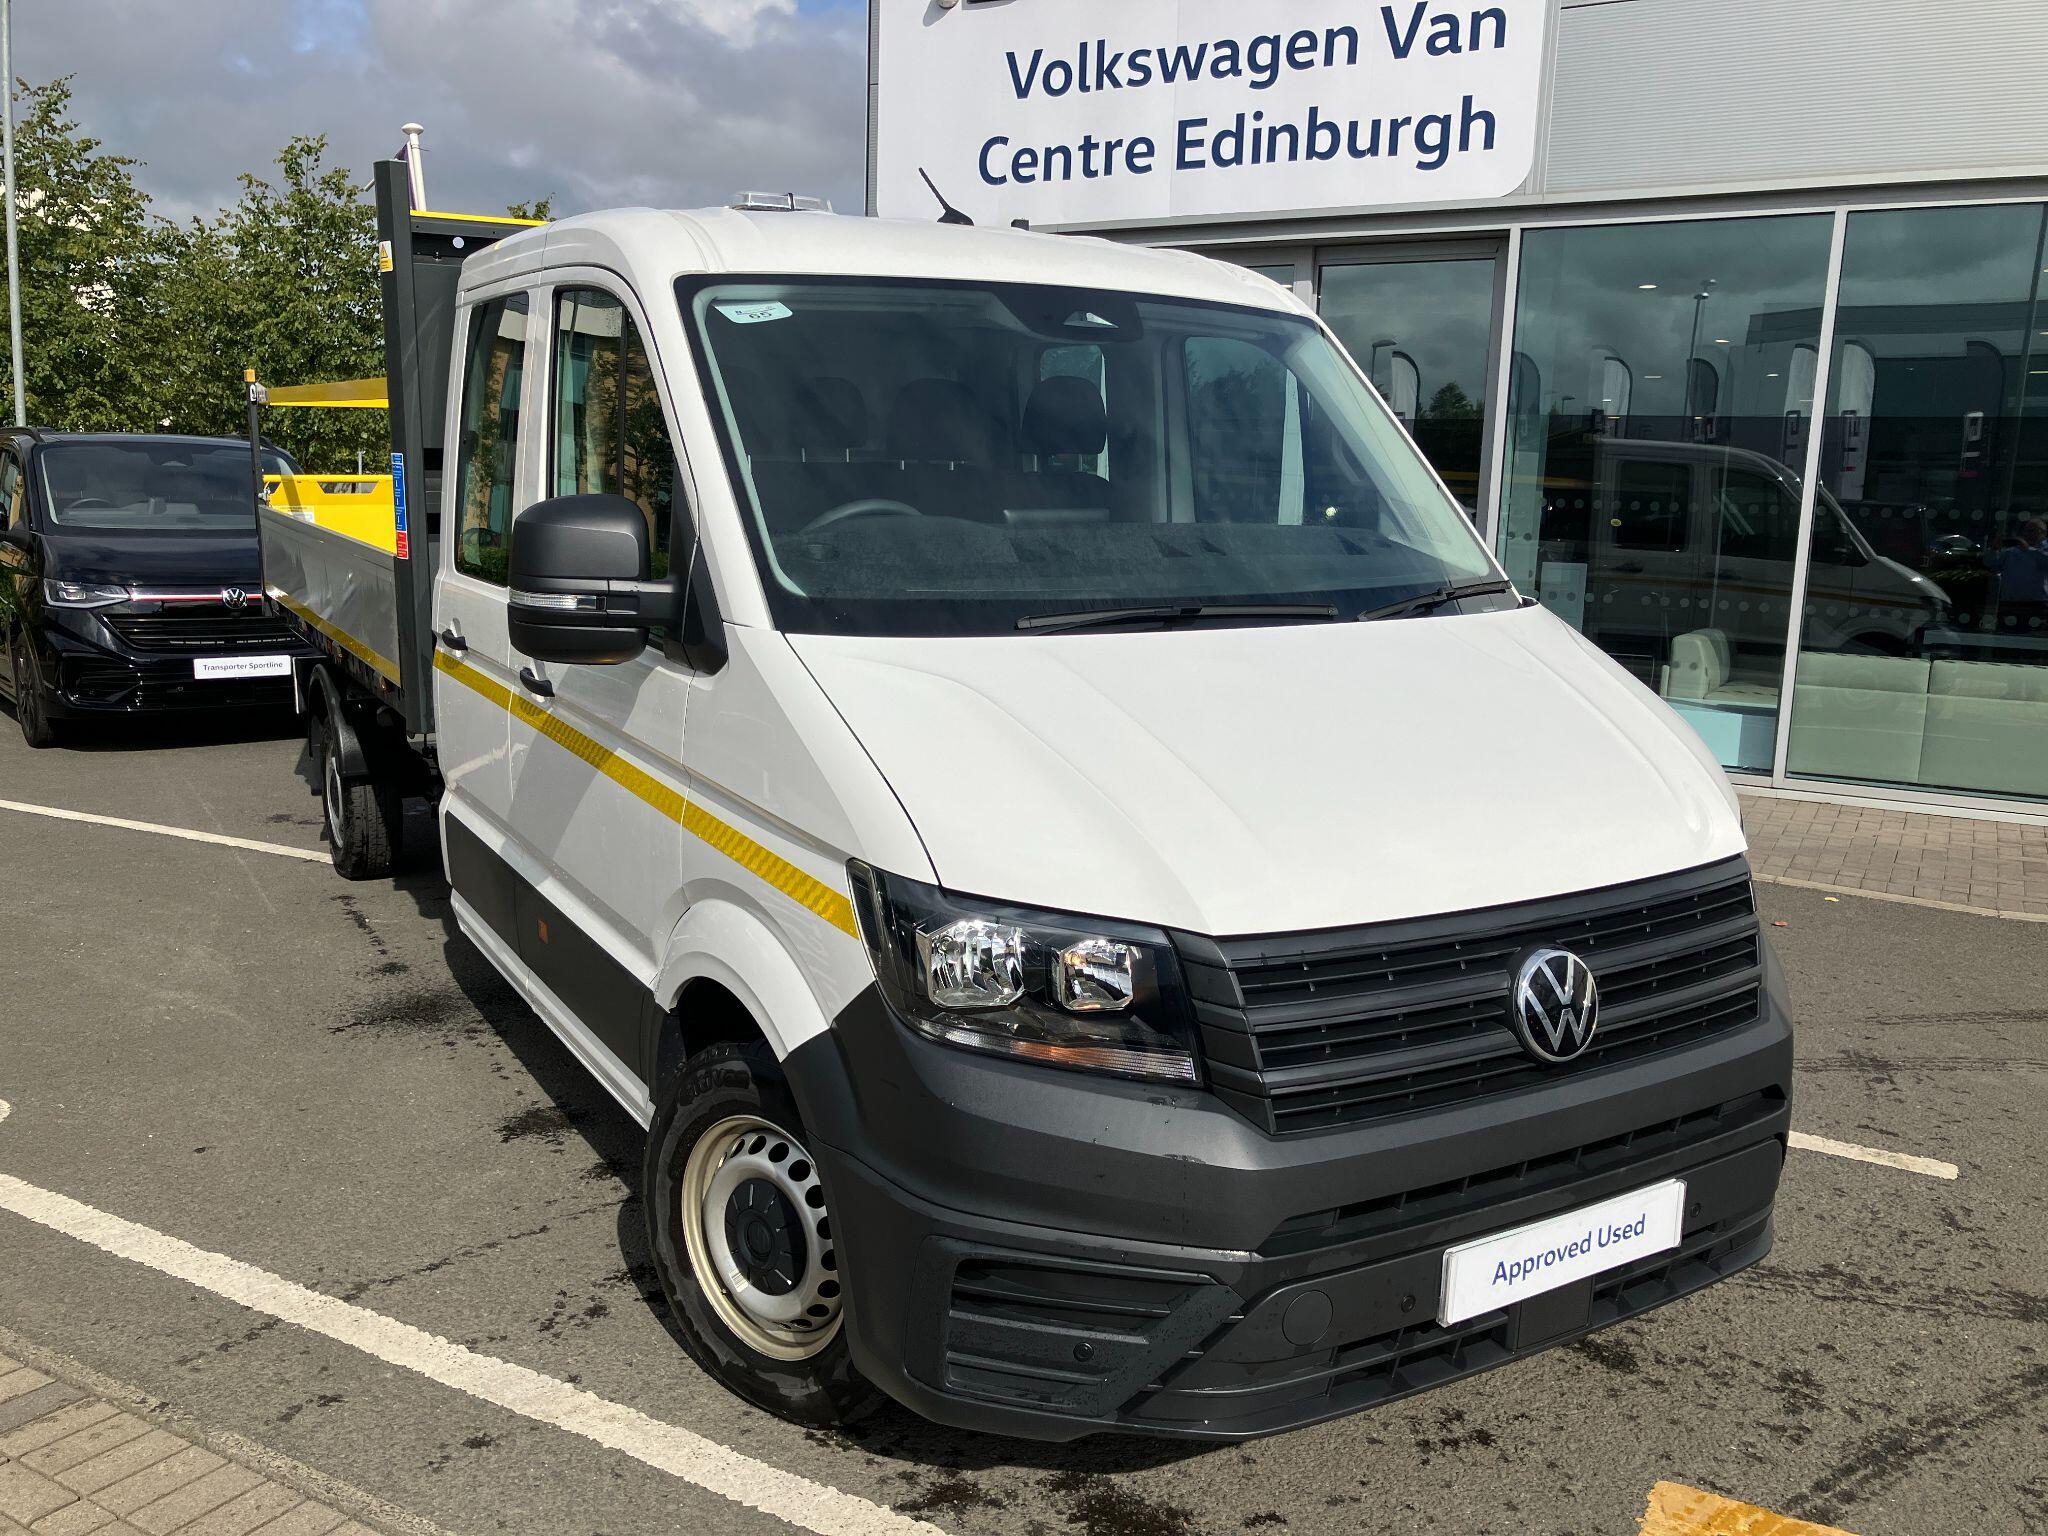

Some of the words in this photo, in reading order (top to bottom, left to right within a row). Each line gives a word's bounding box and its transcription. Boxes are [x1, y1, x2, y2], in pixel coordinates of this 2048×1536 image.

[1005, 25, 1359, 100] Volkswagen
[1380, 1, 1507, 60] Van
[978, 134, 1155, 186] Centre
[1175, 94, 1496, 171] Edinburgh
[203, 663, 247, 671] Transporter
[249, 661, 283, 669] Sportline
[1491, 1230, 1592, 1286] Approved
[1597, 1213, 1646, 1249] Used
